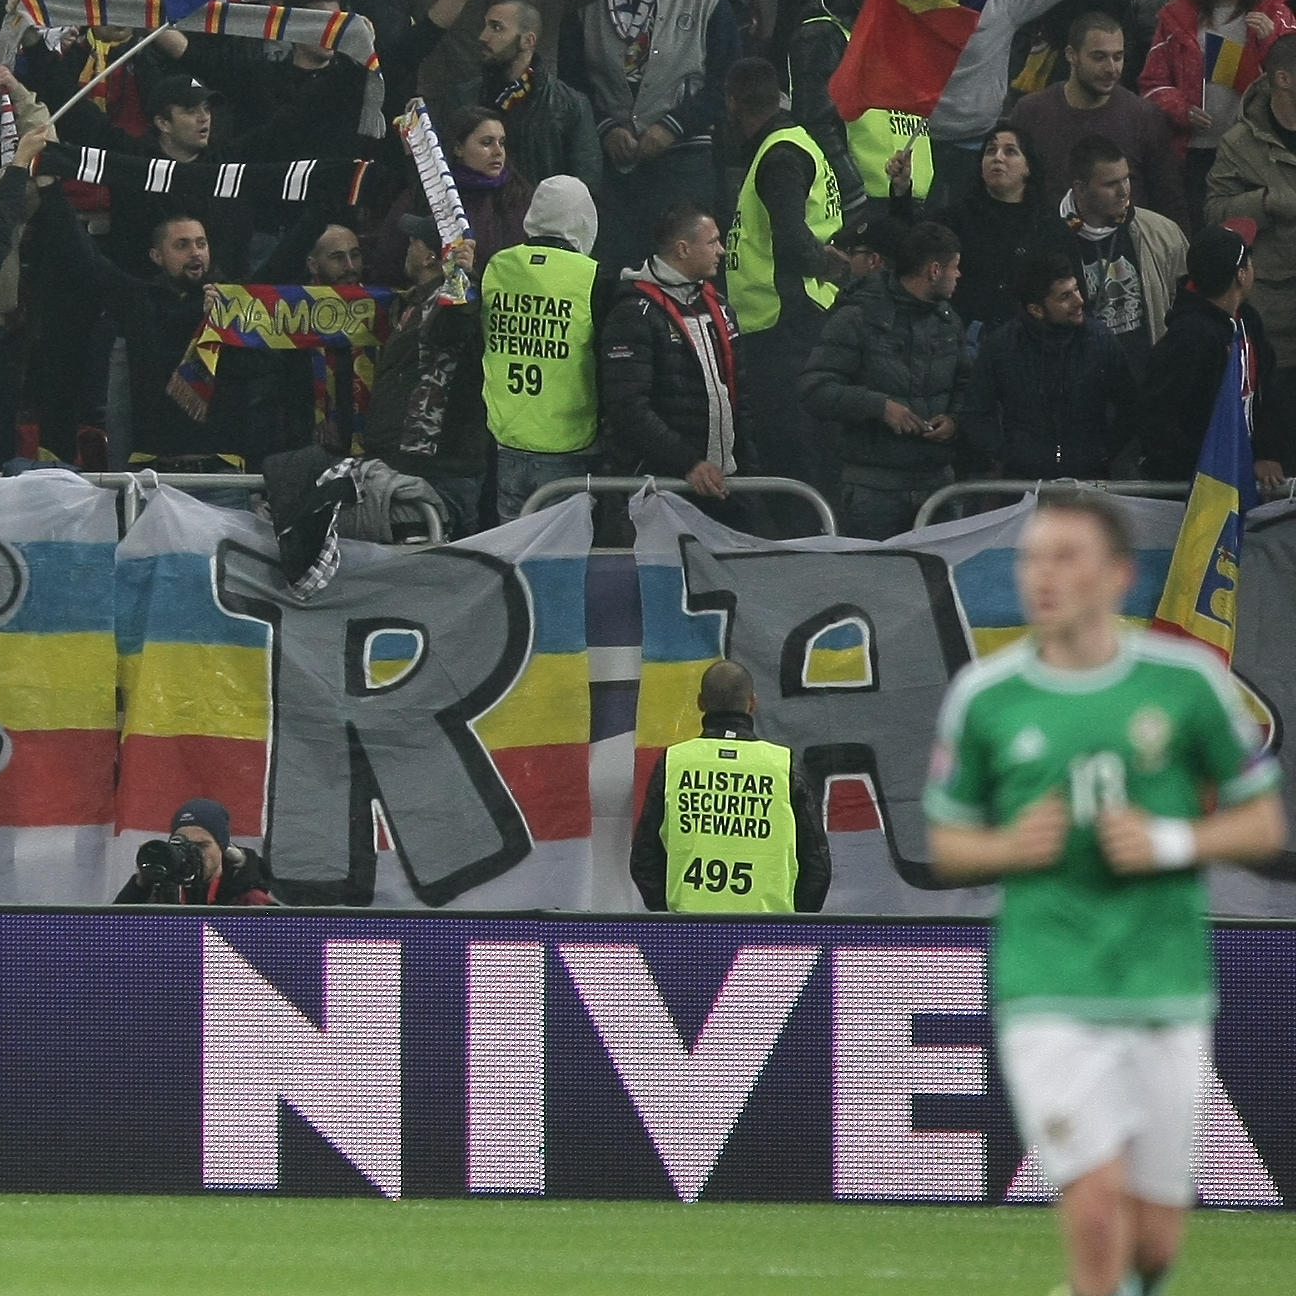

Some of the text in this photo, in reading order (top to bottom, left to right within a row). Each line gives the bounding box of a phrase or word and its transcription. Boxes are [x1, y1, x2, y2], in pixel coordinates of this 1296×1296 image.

[491, 291, 573, 318] ALISTAR
[490, 313, 570, 339] SECURITY
[489, 334, 570, 359] STEWARD
[508, 362, 542, 396] 59
[679, 770, 774, 795] ALISTAR
[678, 793, 772, 817] SECURITY
[680, 814, 771, 839] STEWARD
[683, 857, 753, 894] 495
[201, 920, 1282, 1204] NIVE
